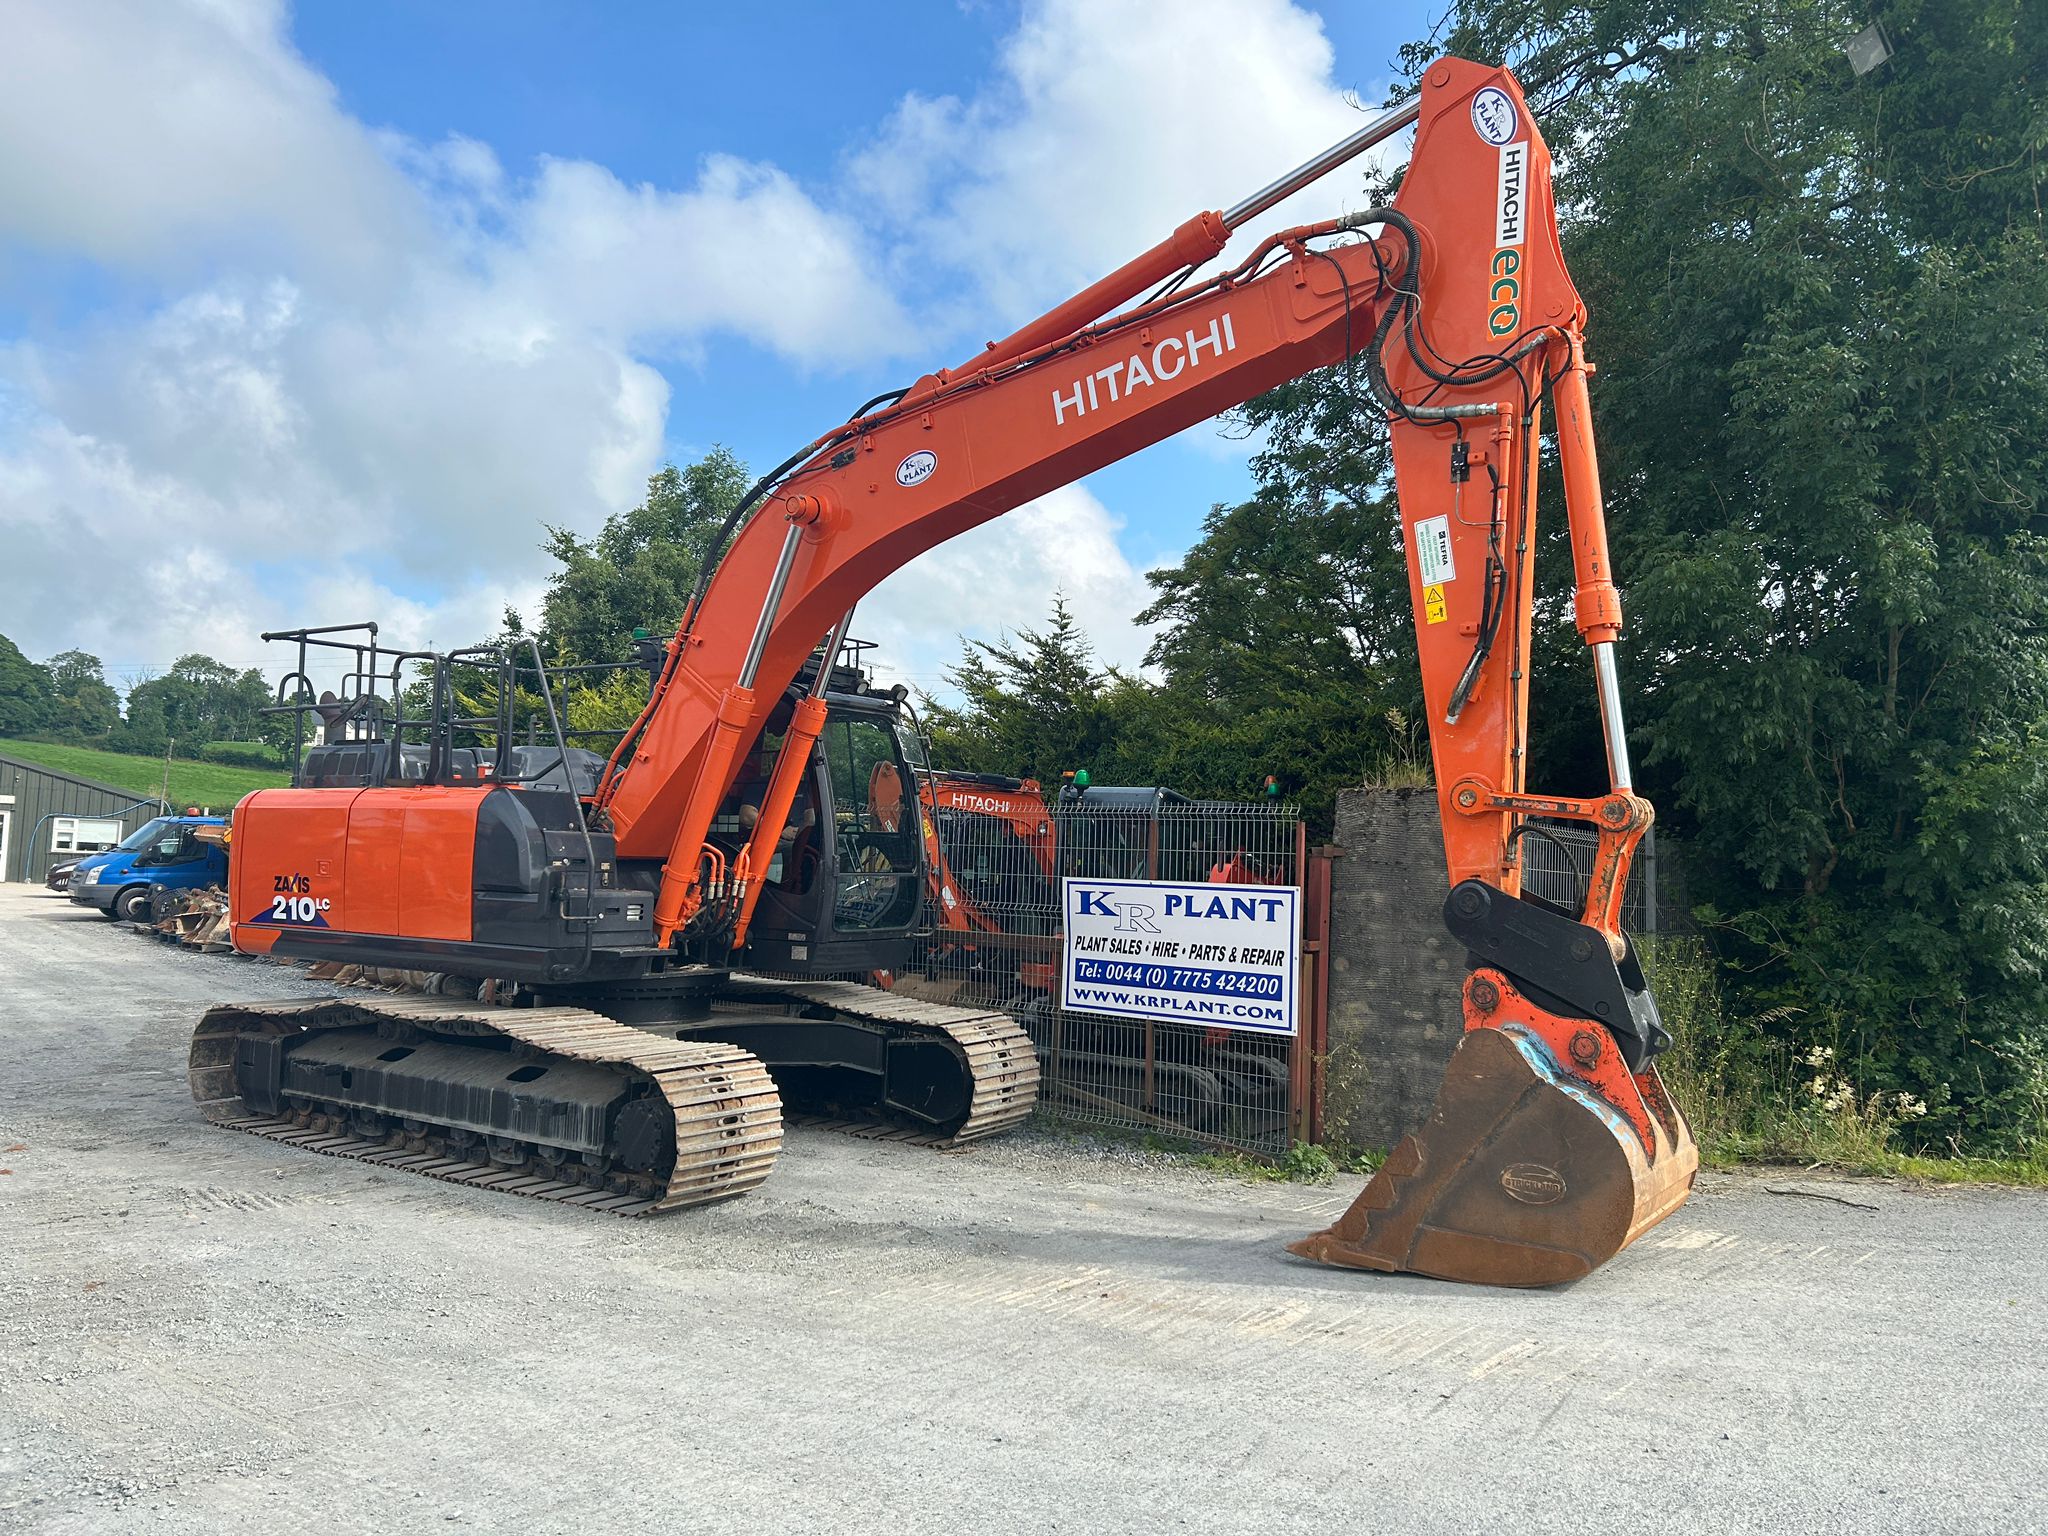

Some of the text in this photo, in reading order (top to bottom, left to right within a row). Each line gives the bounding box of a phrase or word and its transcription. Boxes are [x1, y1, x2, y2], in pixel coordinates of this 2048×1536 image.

[1476, 101, 1502, 140] PLANT
[1502, 149, 1521, 241] HITACHI
[1489, 248, 1520, 337] eco
[1052, 312, 1236, 426] HITACHI
[903, 463, 932, 482] PLANT
[1439, 539, 1448, 565] TEFRA
[951, 792, 1010, 813] HITACHI
[274, 872, 310, 893] ZAXIS
[1164, 894, 1284, 922] PLANT
[1075, 935, 1285, 967] PLANT SALES HIRE PARTS & REPAIR
[1078, 962, 1279, 995] Tel: 0044 (0) 7775 424200
[1074, 989, 1283, 1020] WWW.KRPLANT.COM
